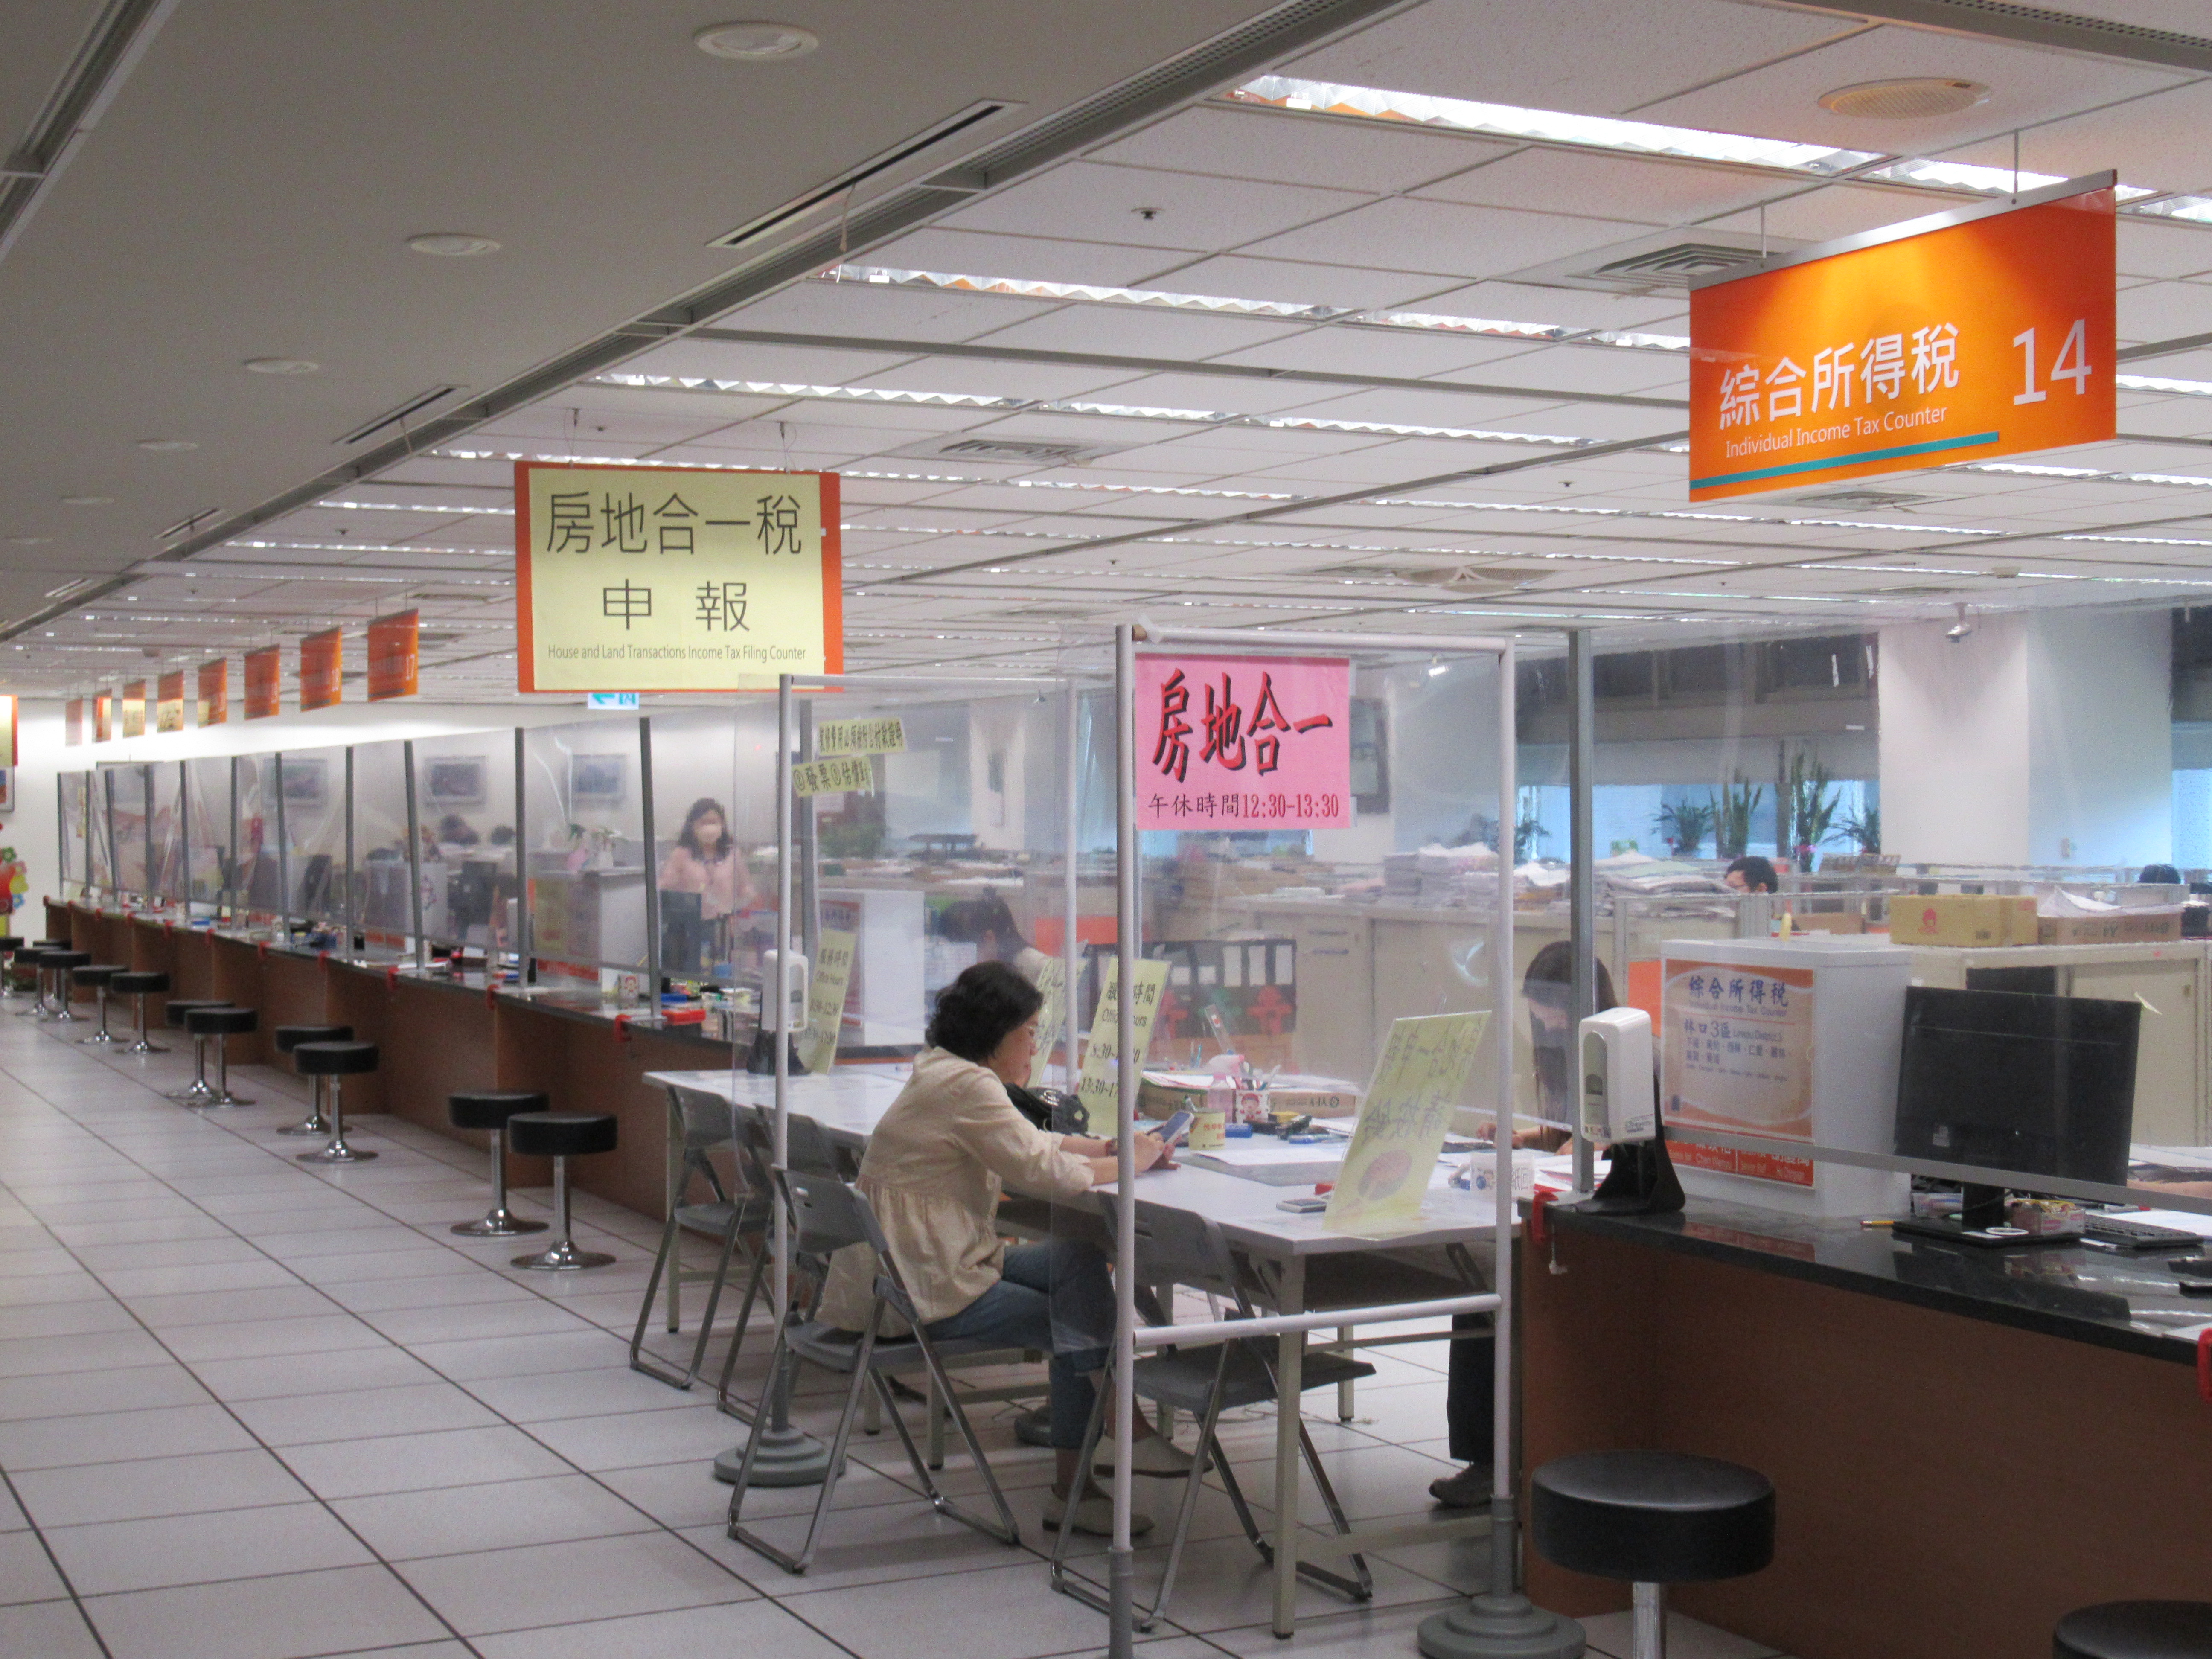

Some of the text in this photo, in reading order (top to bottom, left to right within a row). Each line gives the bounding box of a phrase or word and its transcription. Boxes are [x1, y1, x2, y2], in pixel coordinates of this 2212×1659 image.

[1719, 323, 1960, 431] 綜合所得稅
[2012, 319, 2093, 406] 14
[1726, 407, 1947, 458] Individual Income Tax Counter
[547, 491, 802, 555] 房地合一稅
[406, 653, 415, 681] 17
[548, 645, 806, 663] House and Land Transactions Income Tax Filing Counter
[1151, 667, 1333, 783] 房地合一
[1147, 792, 1339, 818] 午休時間12:30-13:30
[1689, 975, 1789, 1007] 綜合所得稅
